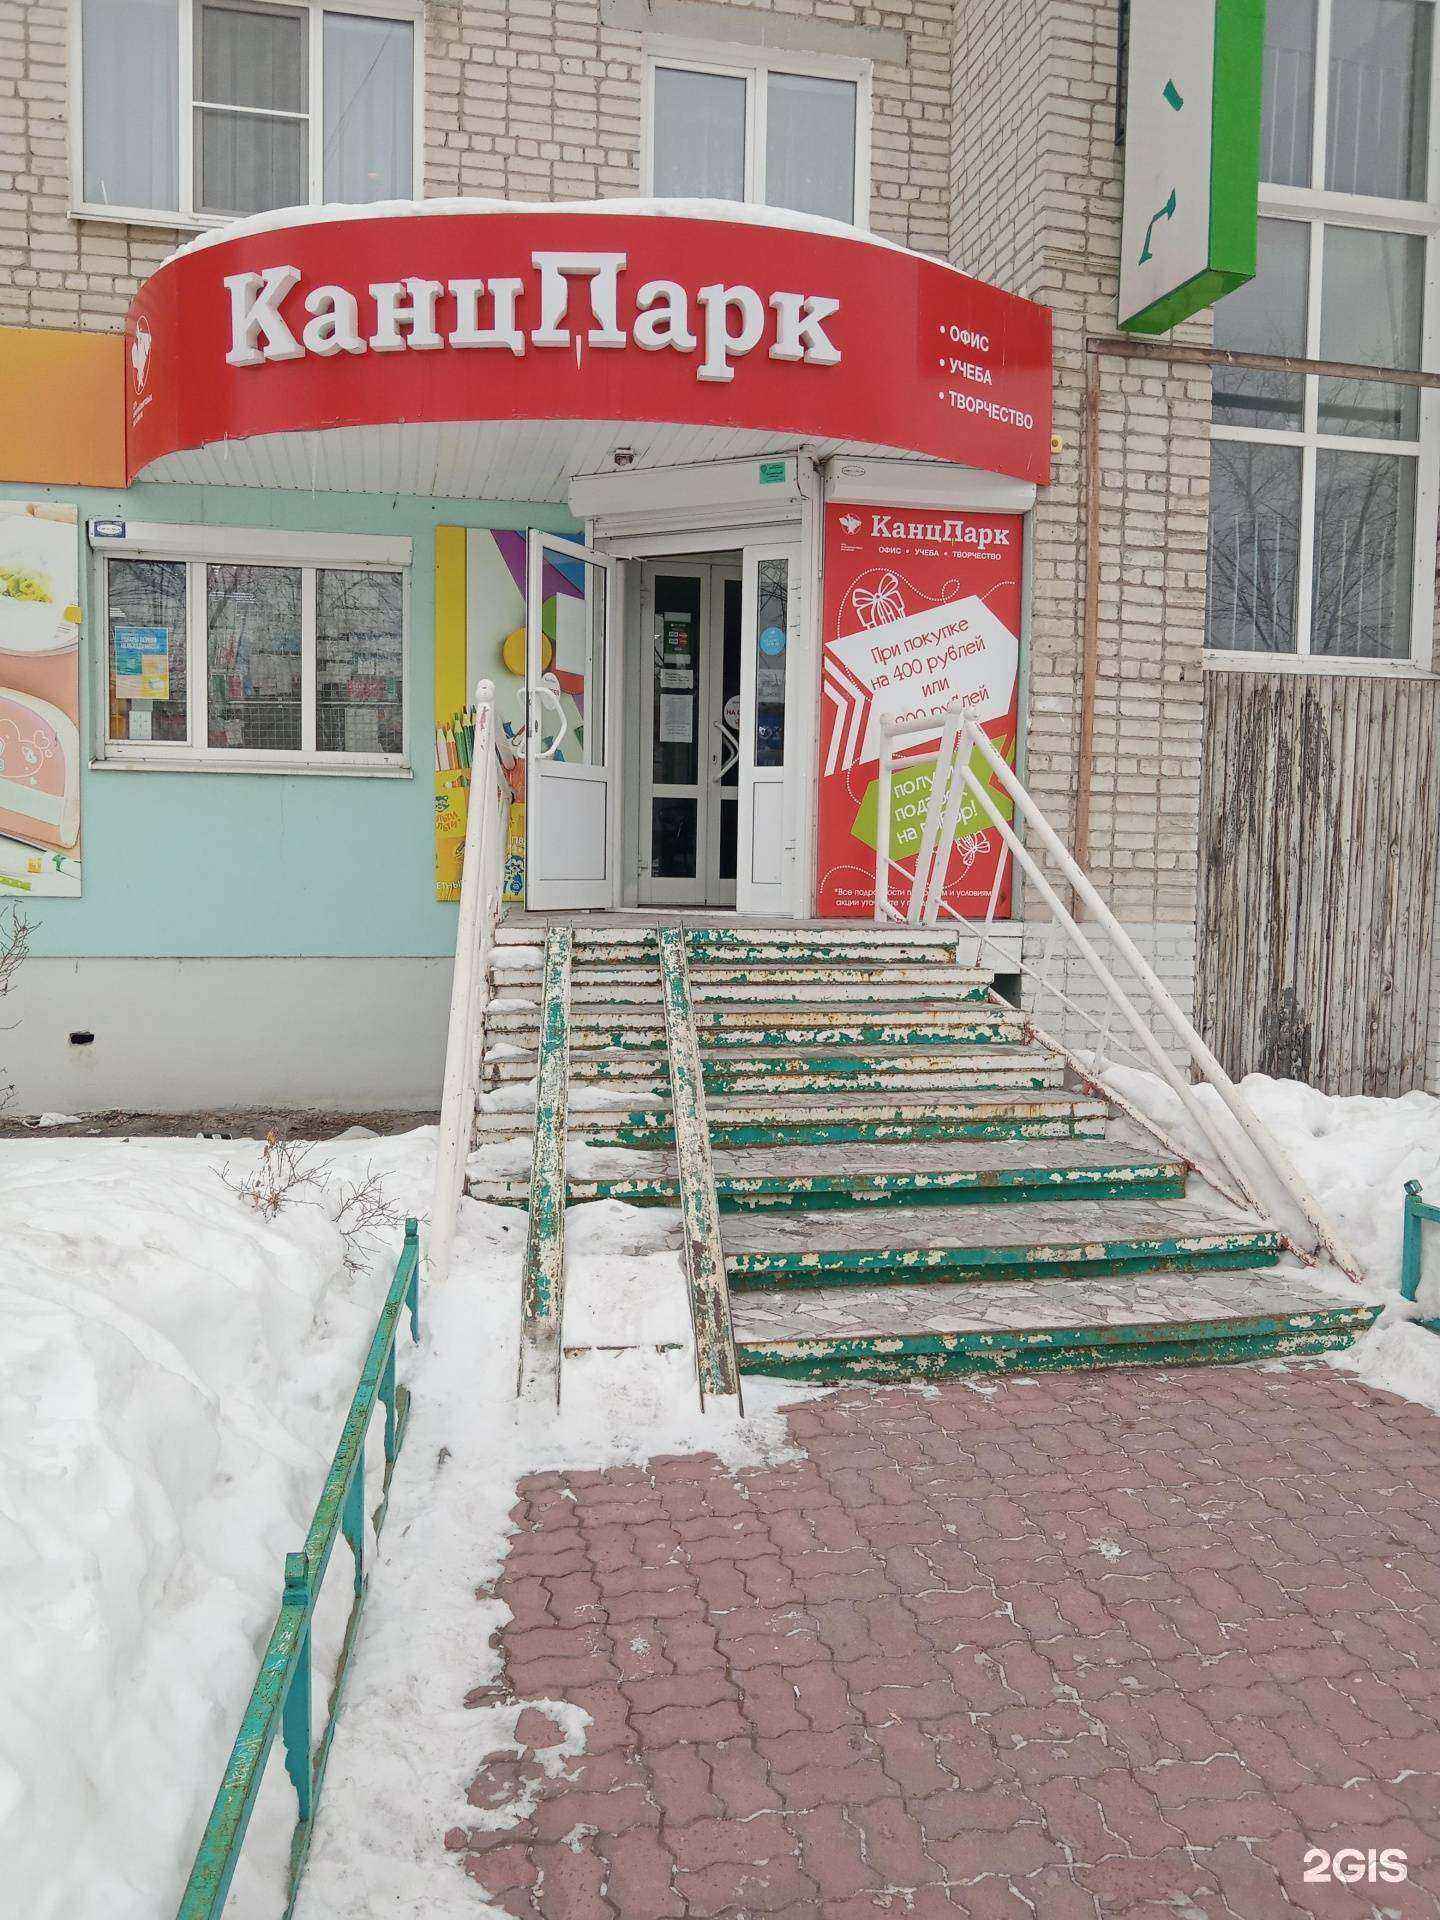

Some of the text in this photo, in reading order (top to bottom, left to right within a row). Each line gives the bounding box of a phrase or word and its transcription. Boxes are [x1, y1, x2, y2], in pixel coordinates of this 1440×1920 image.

[224, 251, 842, 382] КанцПарк
[949, 325, 989, 352] ОФИС
[949, 357, 993, 386] УЧЕБА
[949, 390, 1034, 430] ТВОРЧЕСТВО
[870, 514, 1010, 550] КанцПарк
[878, 546, 1002, 561] ОФИС УЧЕБА ТВОРЧЕСТВО
[871, 620, 969, 665] При покупке
[870, 635, 986, 691] на 400 рублей
[922, 678, 950, 698] или
[896, 827, 918, 845] на
